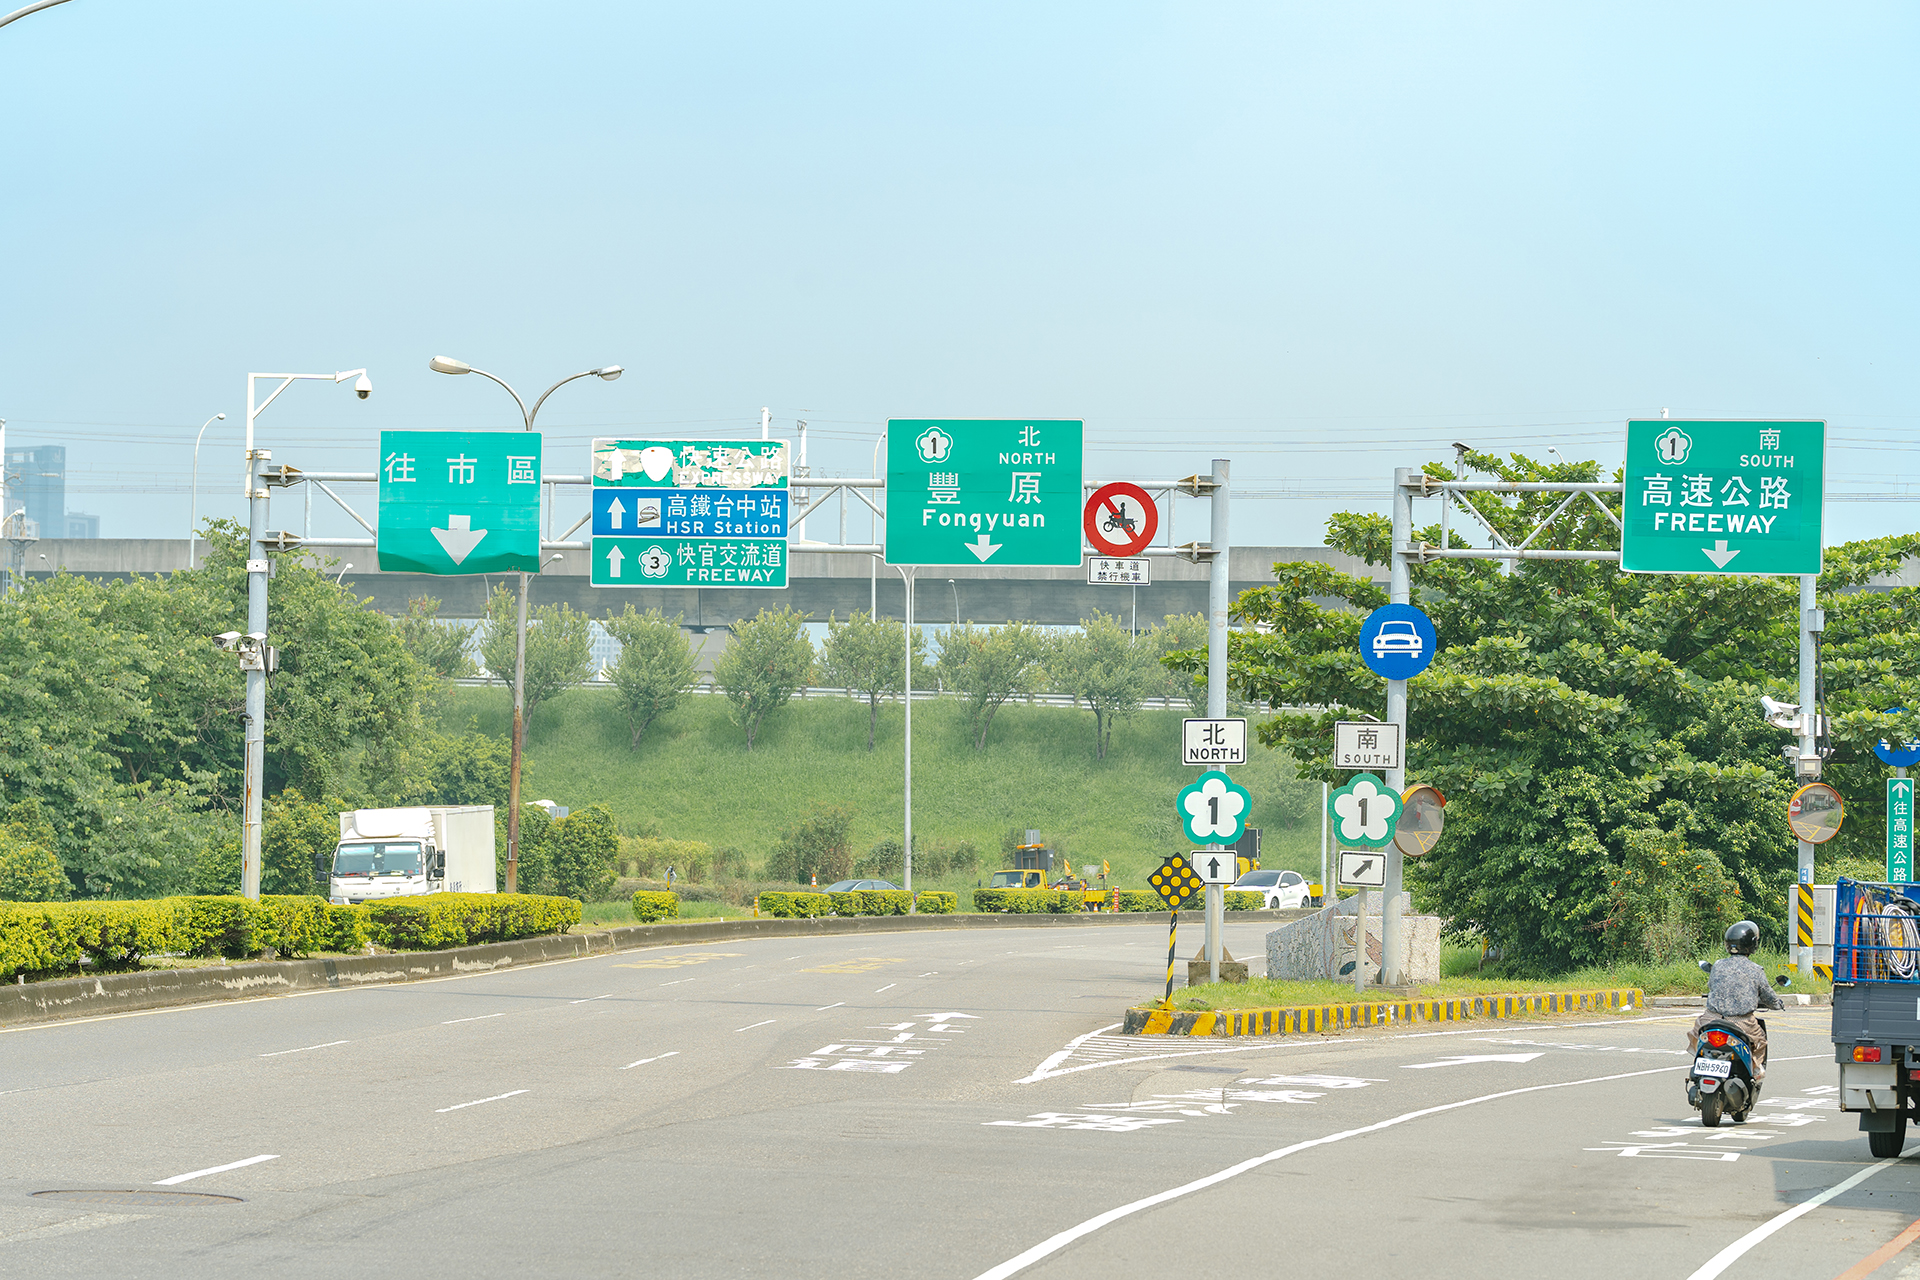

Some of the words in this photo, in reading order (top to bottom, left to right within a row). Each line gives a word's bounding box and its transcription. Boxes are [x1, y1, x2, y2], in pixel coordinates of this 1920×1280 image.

[930, 437, 937, 454] 1
[1018, 425, 1041, 447] 北
[1669, 438, 1676, 456] 1
[1759, 428, 1781, 450] 南
[384, 452, 536, 485] 往市區
[680, 445, 783, 470] 快速公路
[999, 452, 1056, 465] NORTH
[1739, 454, 1794, 468] SOUTH
[680, 471, 783, 485] EXPRESSWAY
[927, 472, 1042, 505] 豐原
[1642, 472, 1792, 509] 高速公路
[667, 493, 781, 518] 高鐵台中站
[667, 521, 704, 533] HSR
[714, 521, 781, 534] Station
[922, 508, 1045, 532] Fongyuan
[1654, 512, 1777, 534] FREEWAY
[650, 556, 660, 569] 3
[676, 542, 782, 567] 快官交流道
[686, 568, 775, 582] FREEWAY
[1202, 723, 1225, 746] 北
[1357, 728, 1379, 749] 南
[1189, 748, 1240, 760] NORTH
[1344, 754, 1391, 764] SOUTH
[1207, 796, 1218, 825] 1
[1358, 798, 1368, 827] 1
[1893, 801, 1908, 882] 往高速公路
